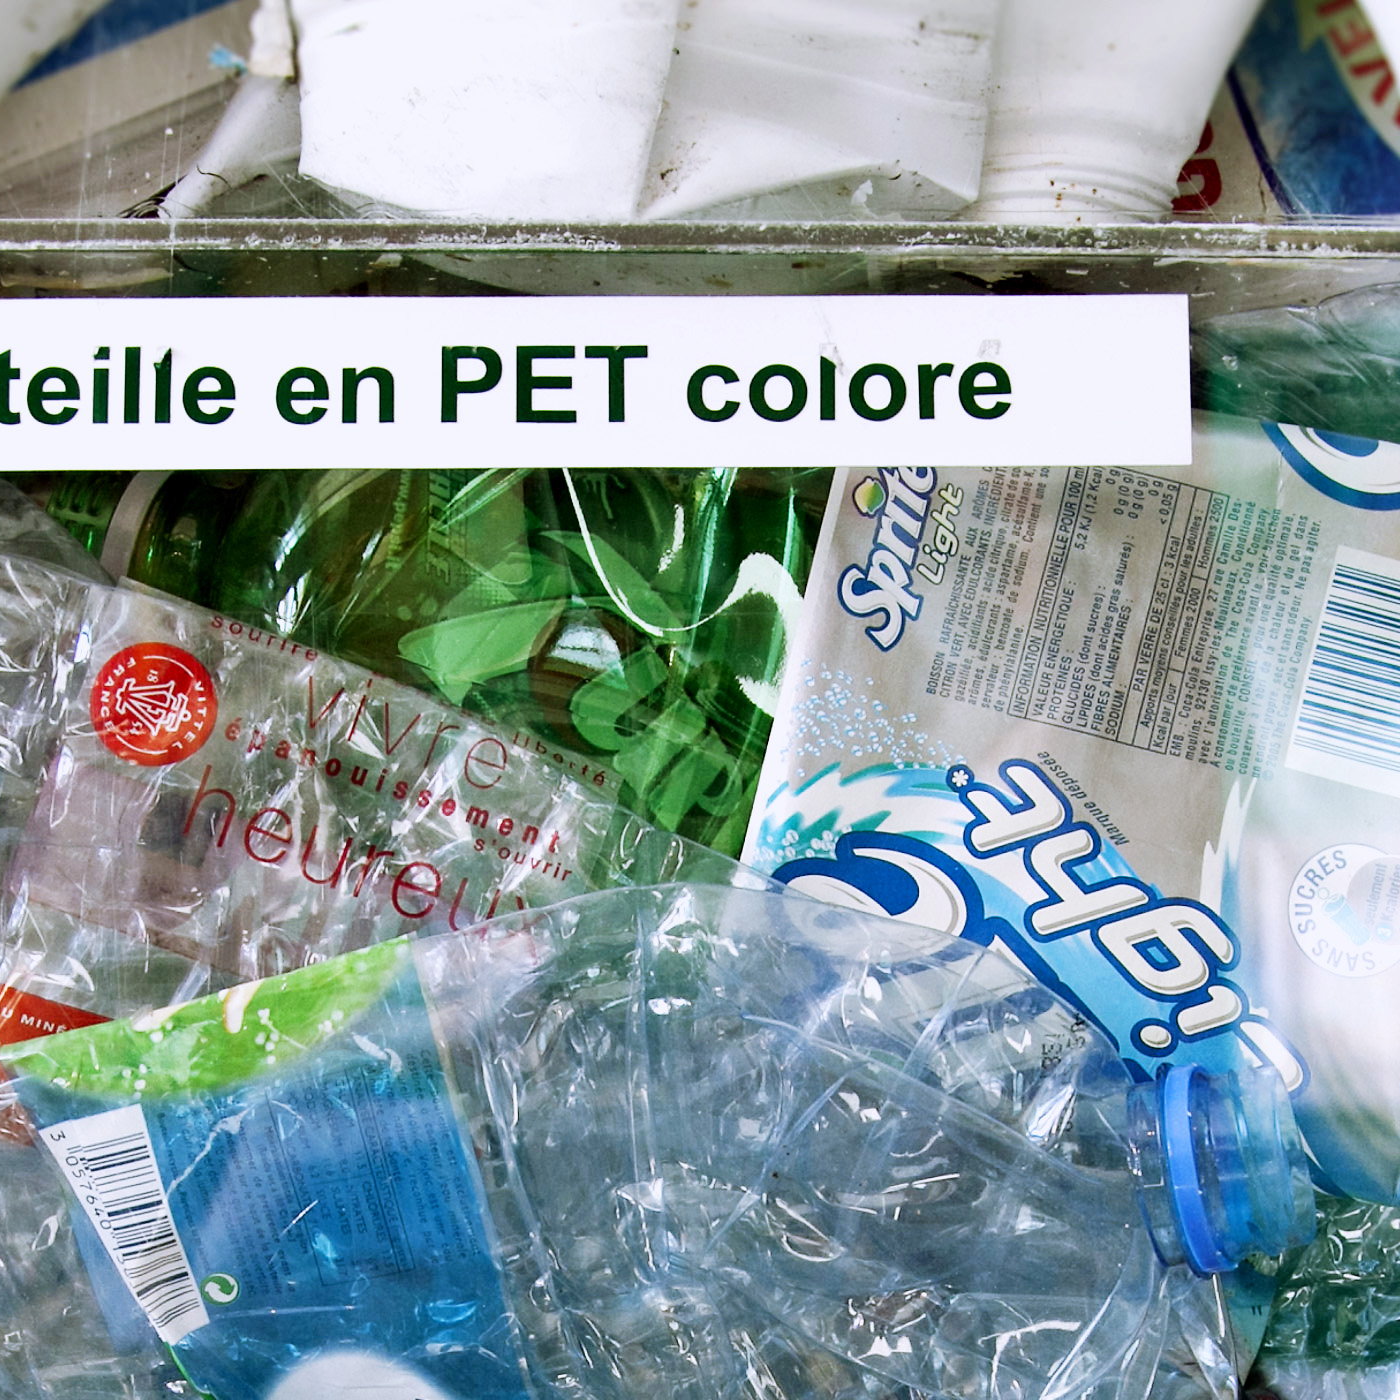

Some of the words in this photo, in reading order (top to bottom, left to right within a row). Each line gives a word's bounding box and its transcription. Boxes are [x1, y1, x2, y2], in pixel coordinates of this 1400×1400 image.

[276, 366, 394, 425] en
[441, 346, 648, 424] PET
[687, 355, 1012, 421] colore
[1079, 514, 1092, 531] KJ
[1208, 497, 1224, 522] 2500
[916, 484, 964, 586] Light
[1074, 531, 1089, 551] 5,2
[1165, 535, 1181, 560] kcal
[1197, 524, 1218, 569] Hommes
[1011, 634, 1043, 713] INFORMATION
[1032, 534, 1070, 631] NUTRITIONNELLE
[1058, 501, 1078, 533] POUR
[1068, 480, 1083, 500] 100
[1149, 606, 1163, 624] DE
[1154, 589, 1168, 605] 25
[1184, 586, 1202, 613] 2000
[211, 614, 319, 662] sourire
[1099, 604, 1133, 688] ALIMENTAIRES
[1138, 624, 1159, 665] VERRE
[1173, 614, 1195, 658] Femmes
[100, 657, 136, 732] FRANCE
[1030, 669, 1053, 717] VALEUR
[1131, 666, 1149, 692] PAR
[1163, 682, 1179, 704] jour
[172, 681, 208, 749] VITTEL
[303, 672, 509, 791] vivre
[1089, 688, 1111, 731] FIBRES
[1104, 688, 1126, 736] SODIUM
[1159, 705, 1174, 724] par
[1151, 723, 1167, 748] Kcal
[224, 716, 561, 853] épanouissement
[1035, 745, 1088, 805] déposée
[1082, 796, 1129, 849] Marque
[1295, 850, 1346, 934] SUCRES
[1365, 863, 1387, 925] seulement
[1312, 939, 1375, 971] SANS
[20, 1016, 67, 1033] MINÉ
